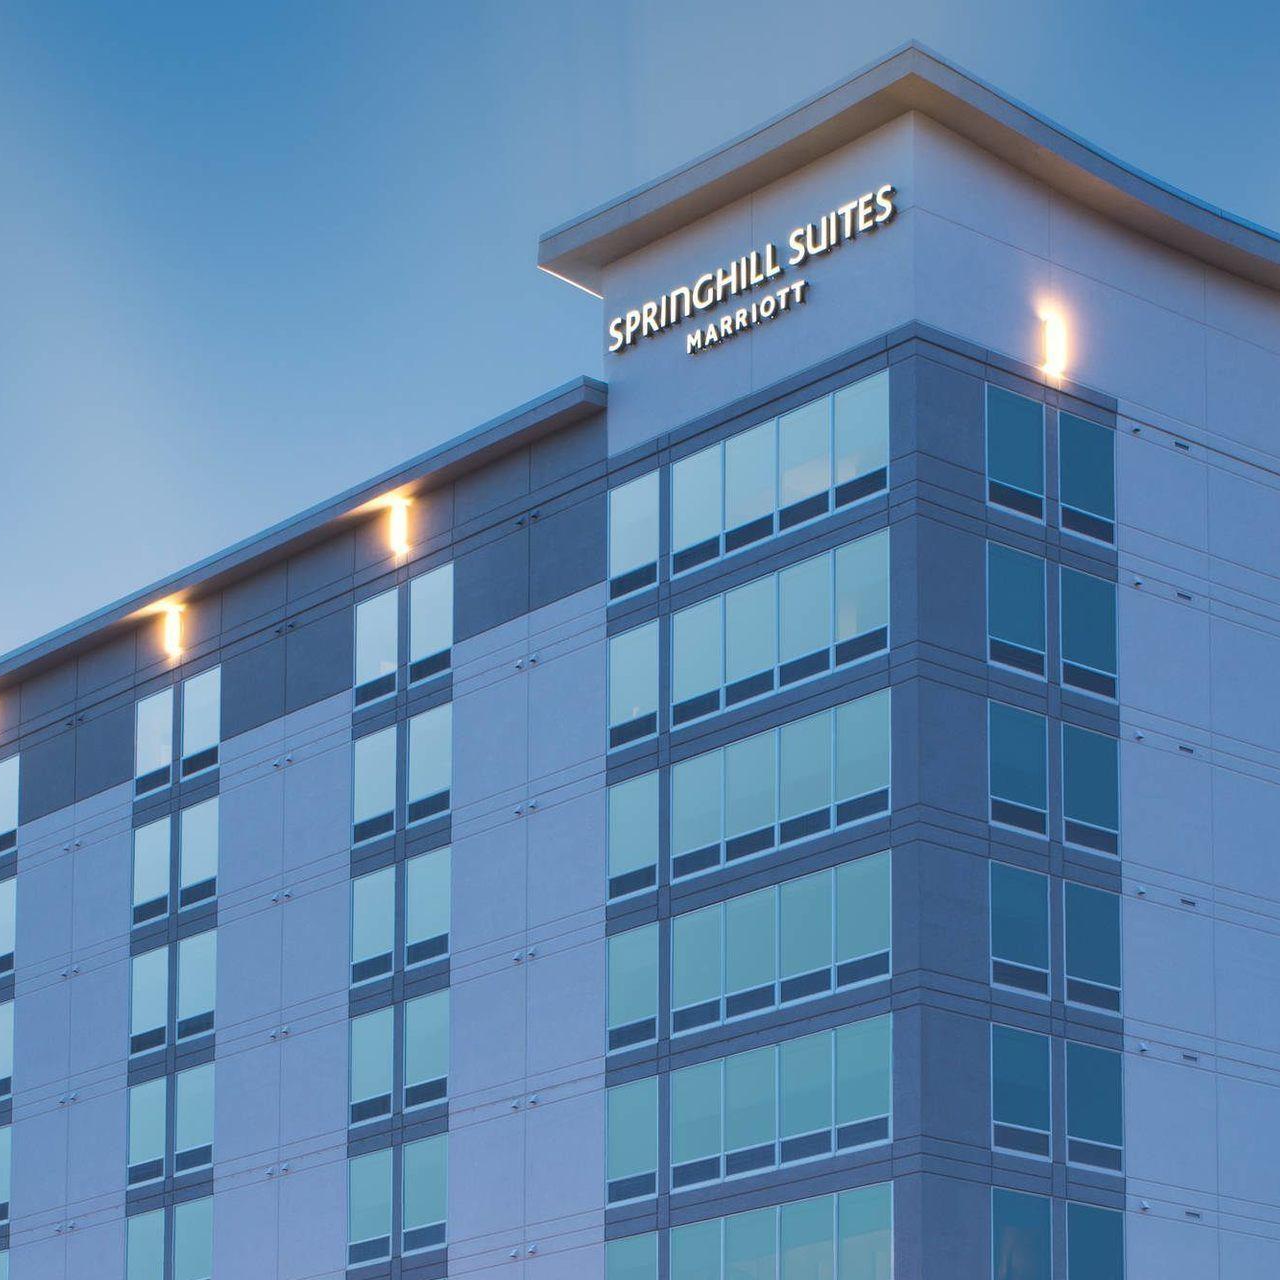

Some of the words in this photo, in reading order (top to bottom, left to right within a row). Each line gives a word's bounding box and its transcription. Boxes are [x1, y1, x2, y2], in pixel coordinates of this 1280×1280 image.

[608, 242, 781, 353] SPRINGHILL
[789, 183, 894, 267] SUITES
[686, 279, 808, 355] MARRIOTT
